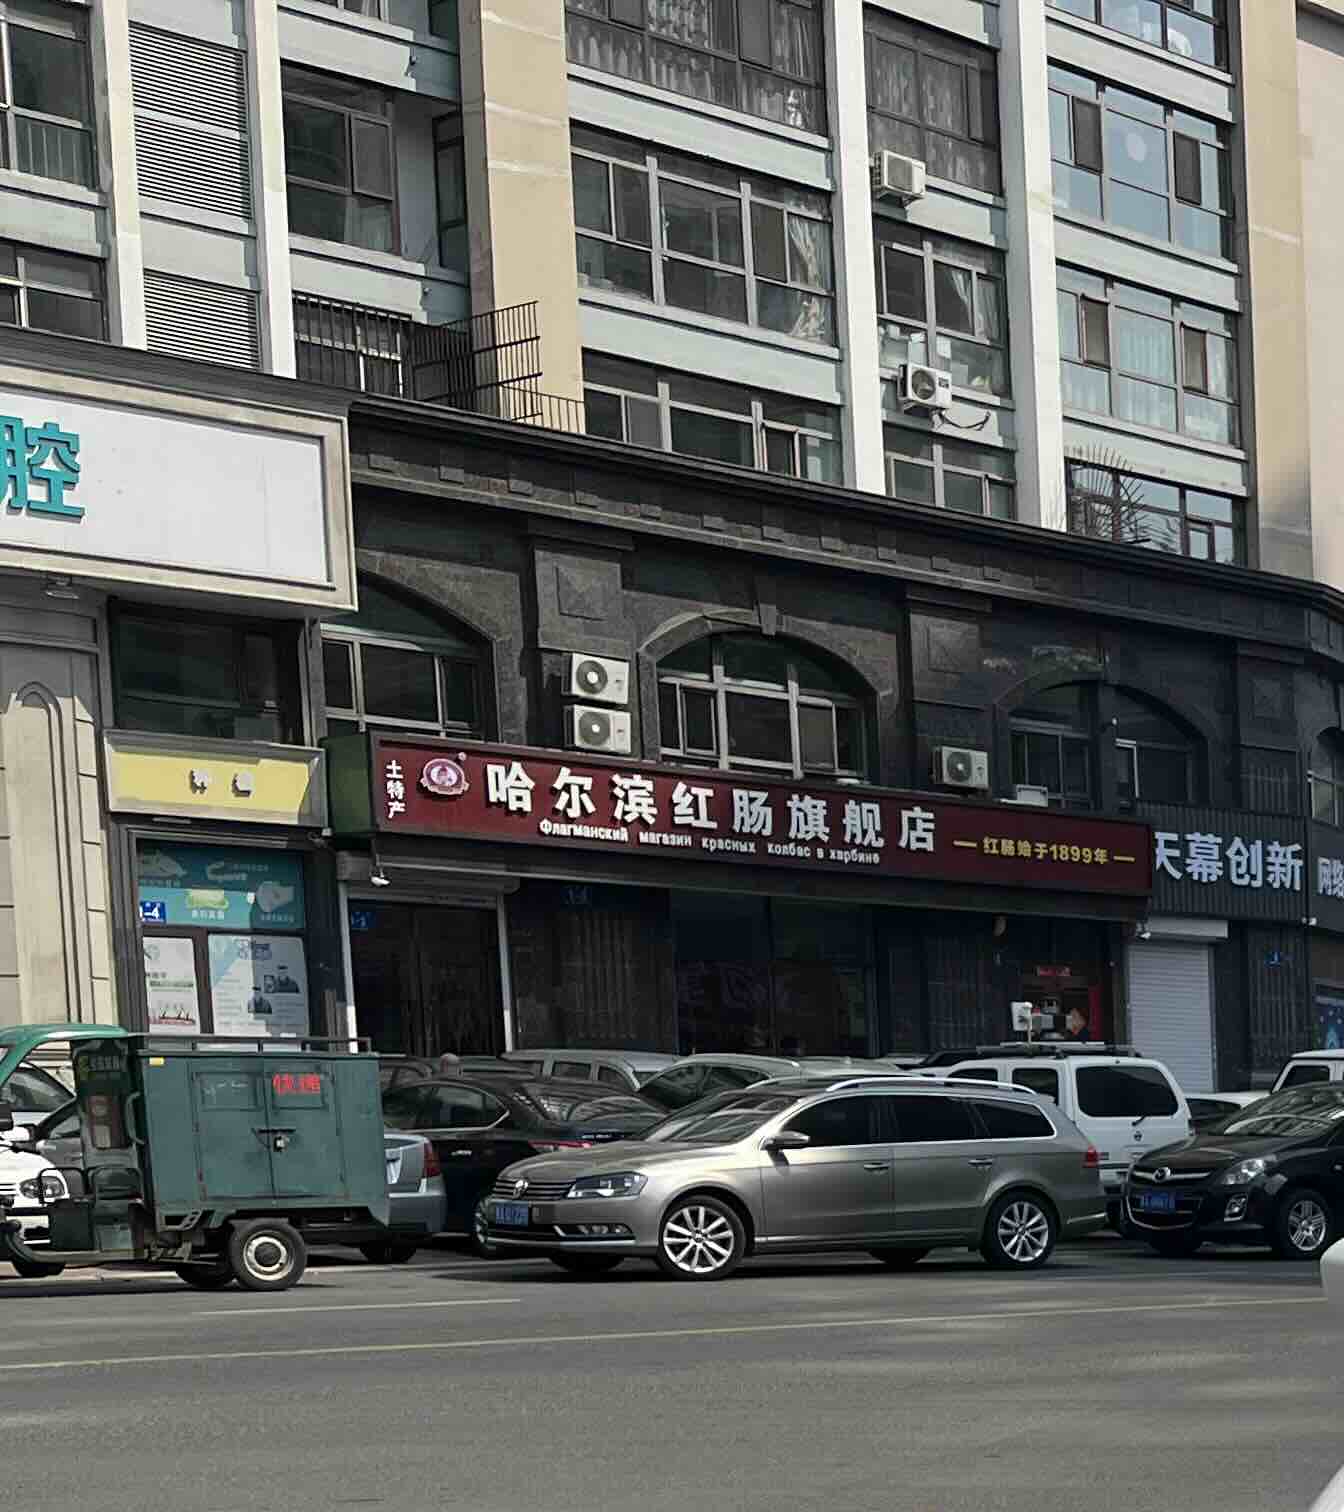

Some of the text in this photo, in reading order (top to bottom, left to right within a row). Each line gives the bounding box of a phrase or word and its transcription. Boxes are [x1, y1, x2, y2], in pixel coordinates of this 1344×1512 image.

[0, 415, 86, 519] 腔
[386, 759, 406, 819] 土特产
[486, 761, 935, 852] 哈尔滨红肠旗舰店
[539, 819, 629, 843] Флагманский
[639, 831, 692, 848] магазин
[701, 838, 756, 855] красных
[767, 842, 811, 858] колбас
[1154, 831, 1304, 892] 天幕创新
